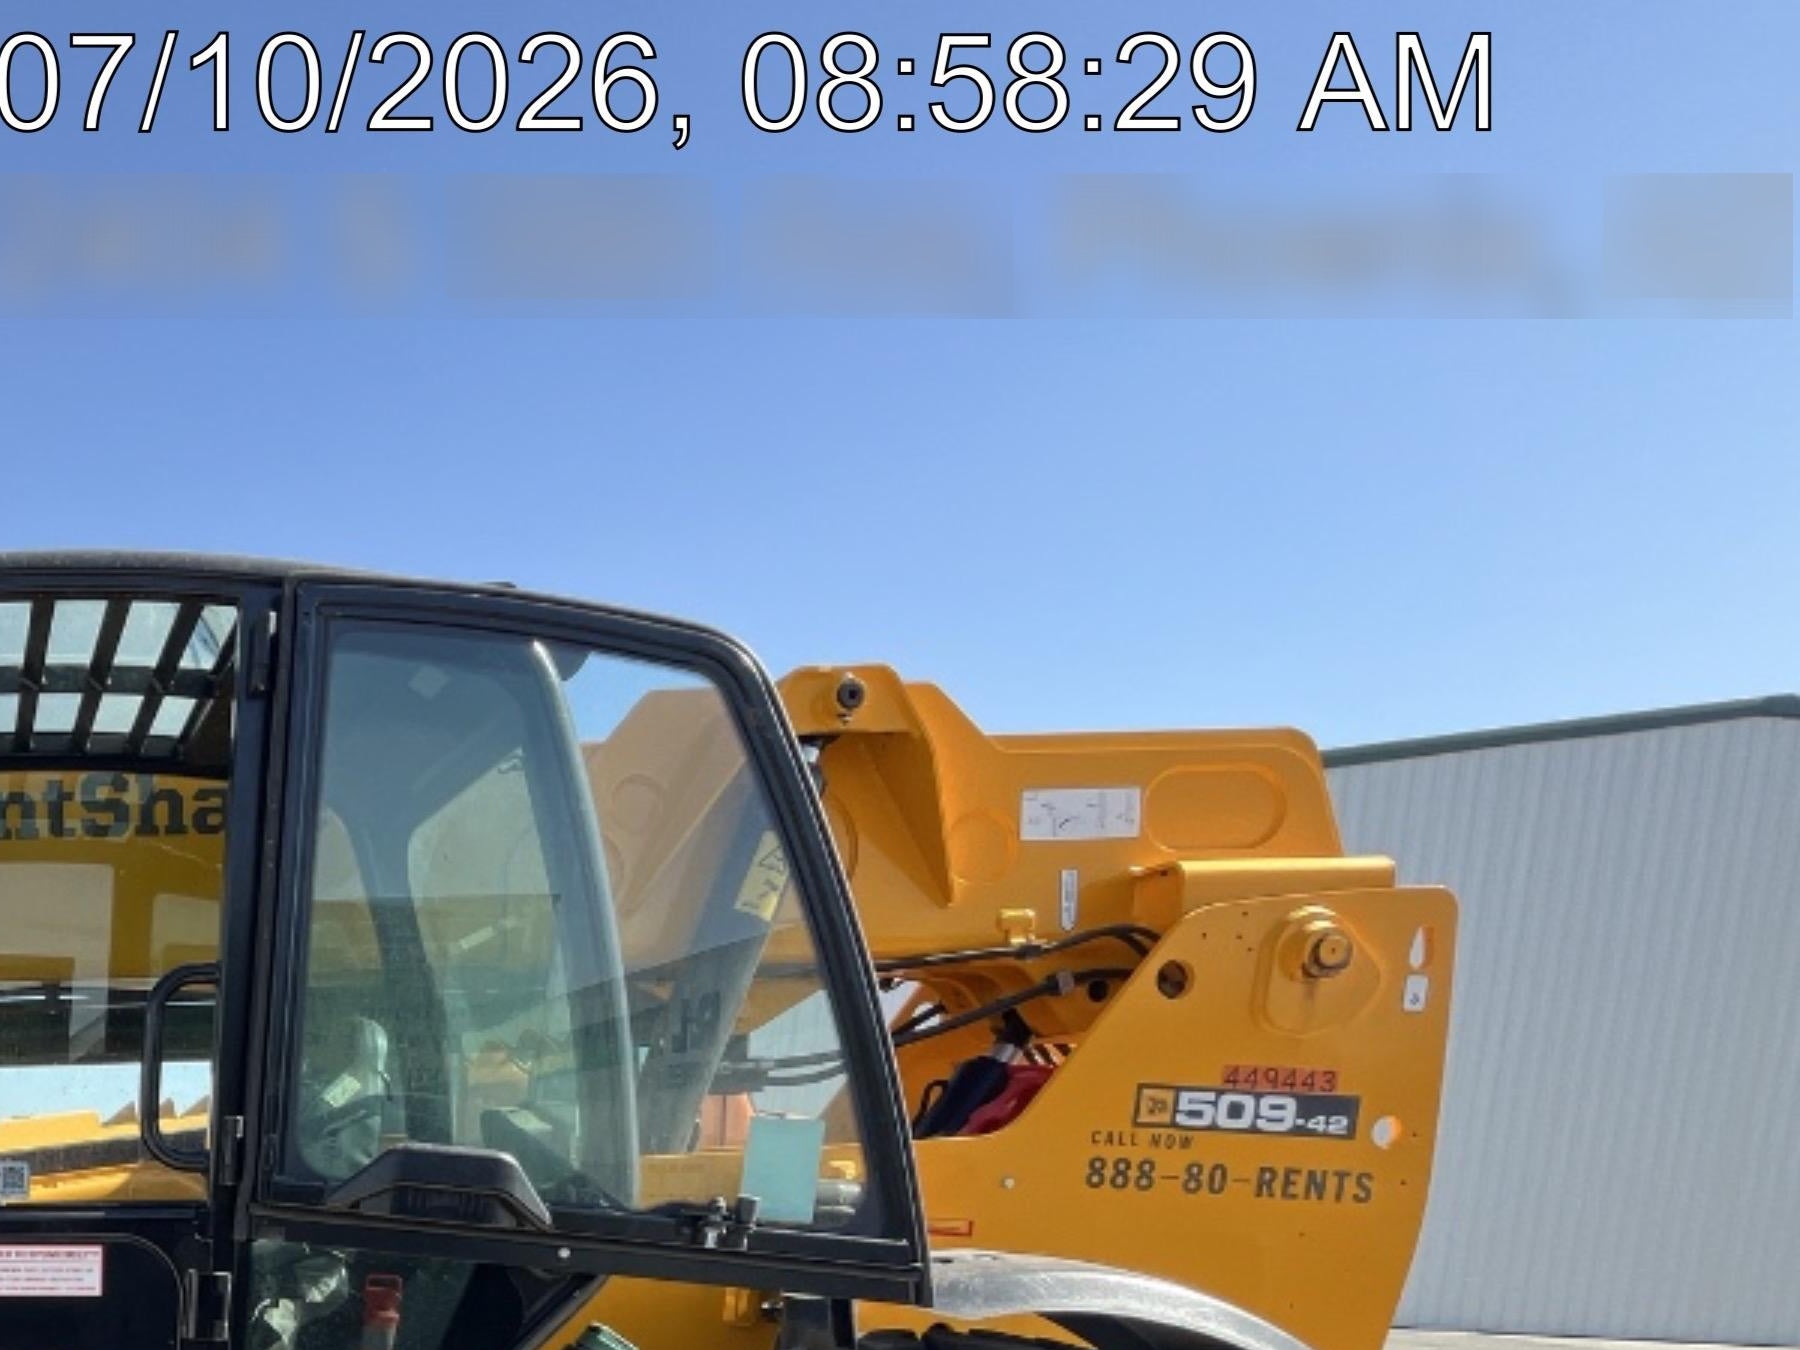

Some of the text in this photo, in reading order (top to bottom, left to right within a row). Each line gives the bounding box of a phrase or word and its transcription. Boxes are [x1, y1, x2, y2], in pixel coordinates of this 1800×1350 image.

[1224, 1065, 1338, 1093] 449443
[1090, 1130, 1195, 1151] CALL NOW
[1084, 1155, 1375, 1204] 888-80-RENTS
